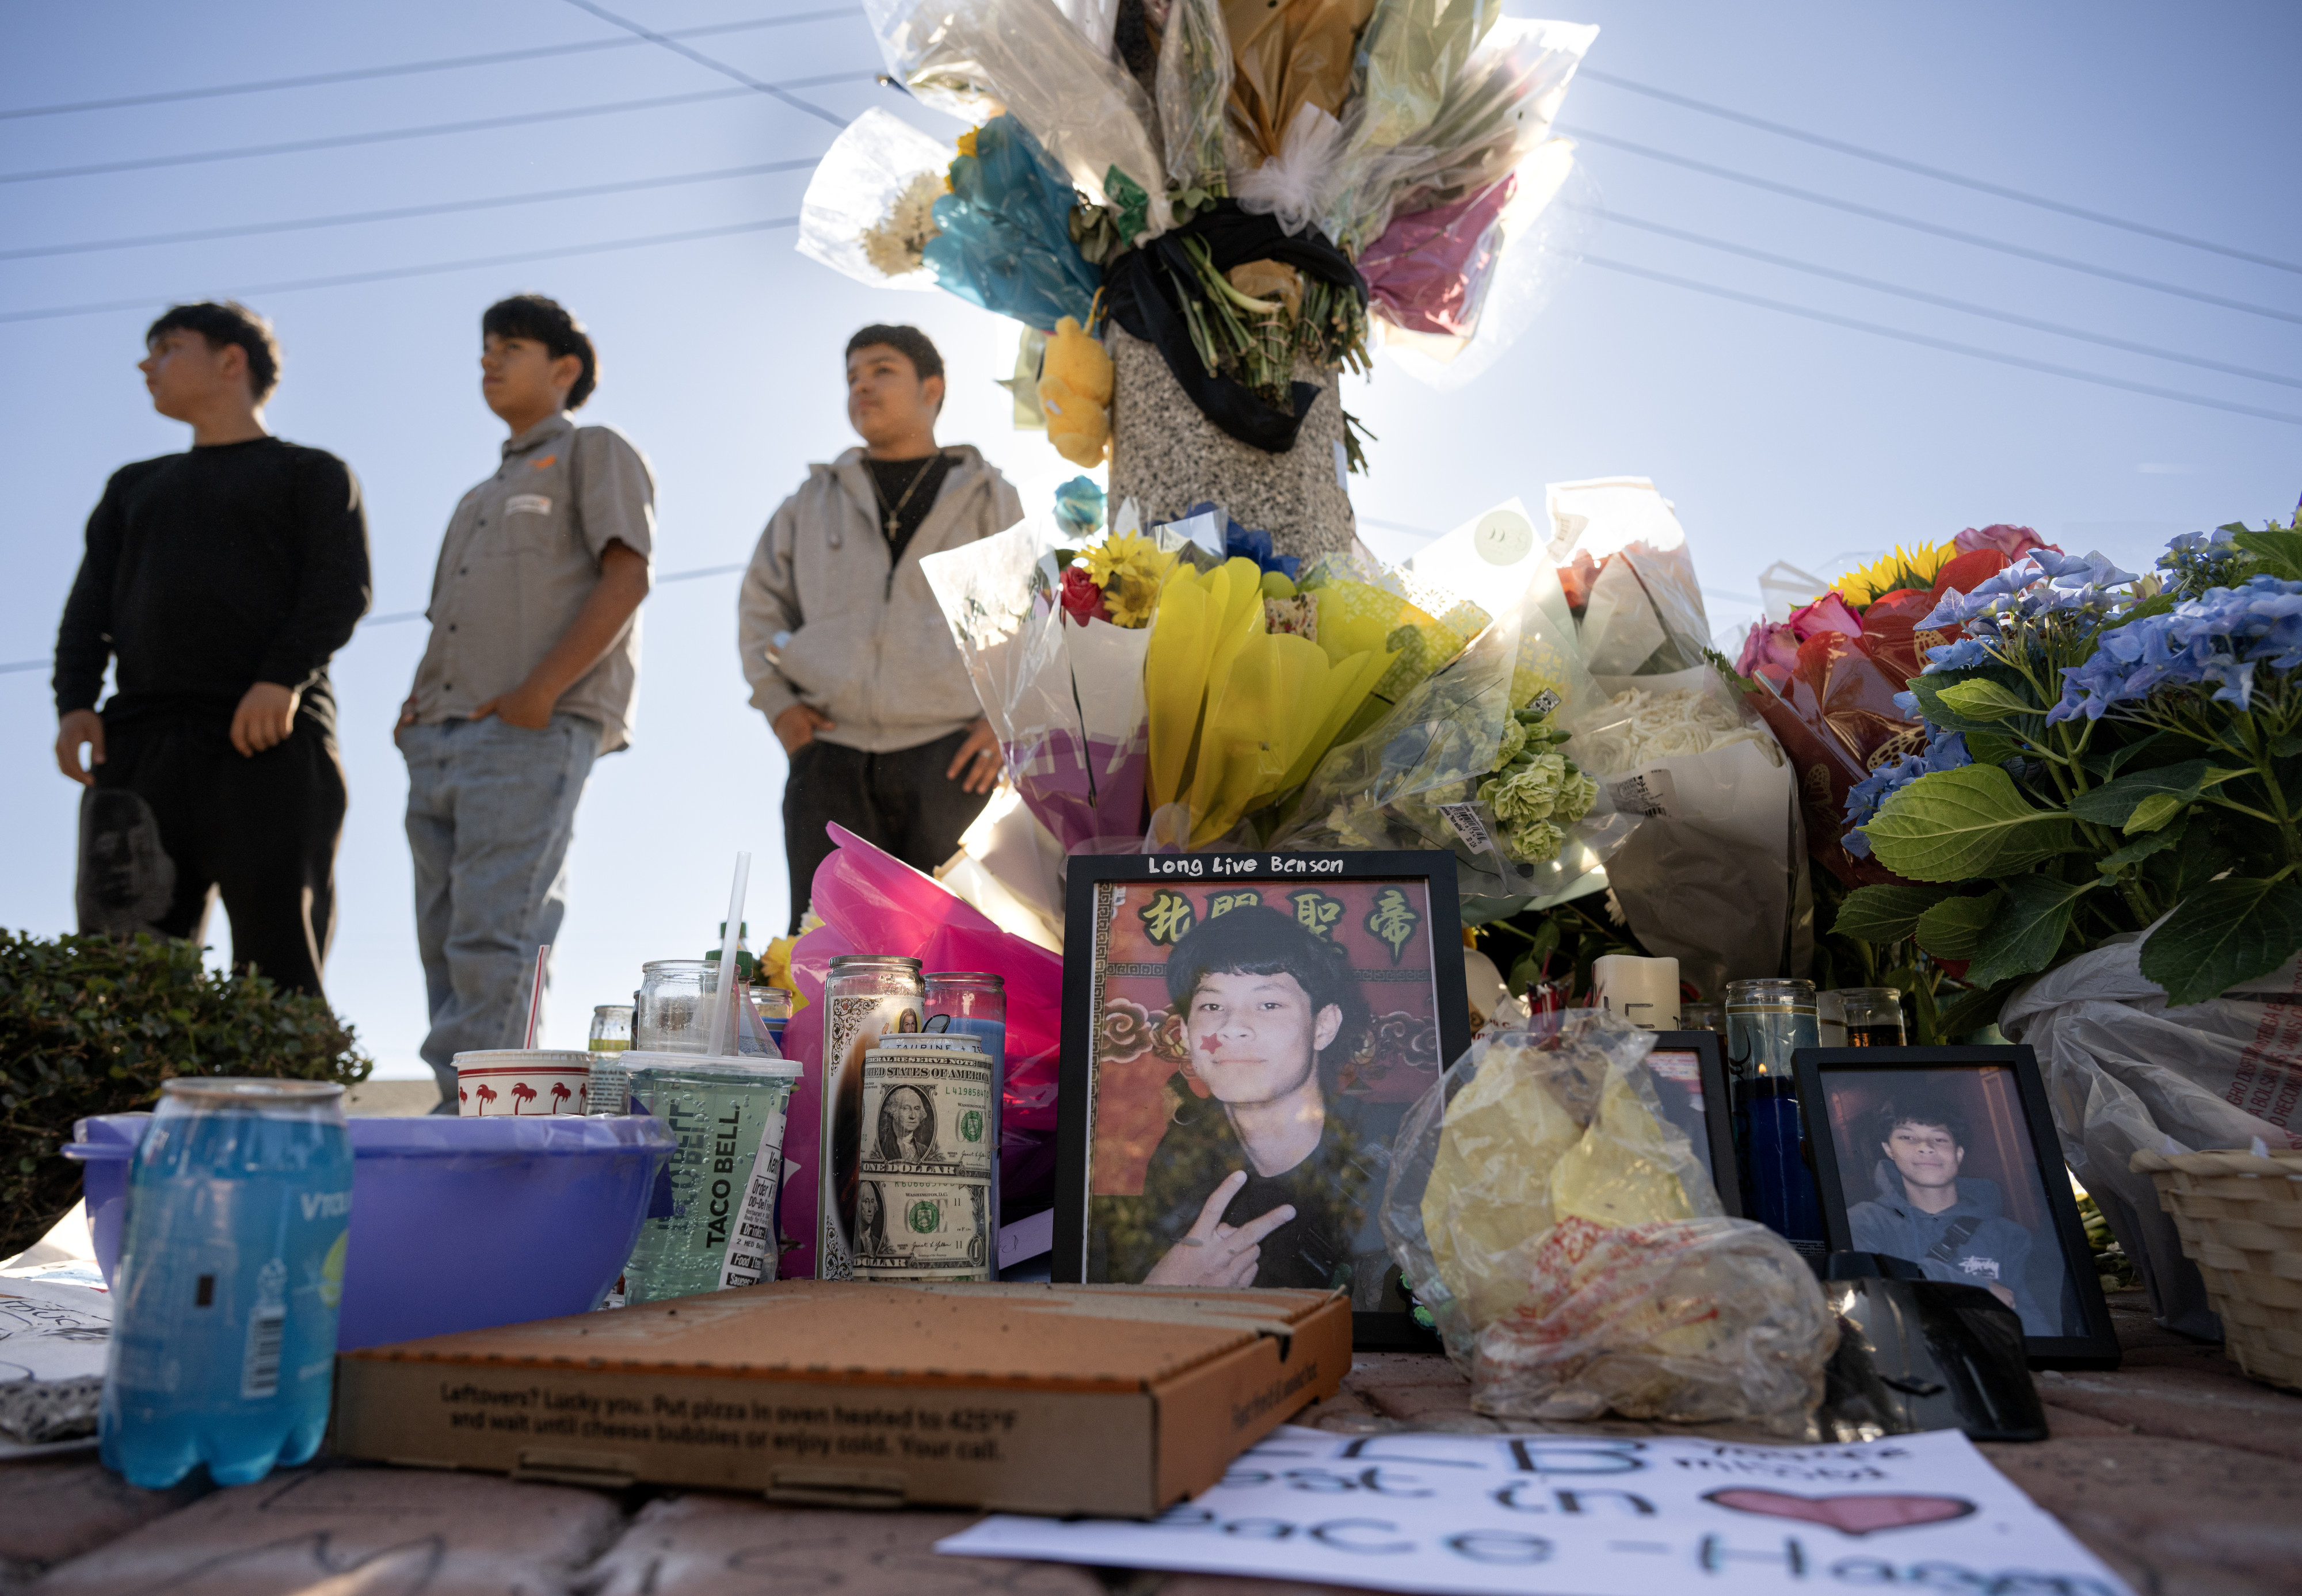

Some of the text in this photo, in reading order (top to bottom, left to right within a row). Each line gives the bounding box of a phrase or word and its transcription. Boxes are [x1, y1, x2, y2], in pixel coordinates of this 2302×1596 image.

[1149, 856, 1344, 876] Long Live Benson
[865, 1067, 990, 1082] NITED STATES OF AMERICA
[863, 1162, 885, 1171] ONE
[887, 1164, 956, 1174] DOLLAR
[706, 1109, 740, 1248] TACO BELL
[752, 1179, 769, 1197] Order
[734, 1253, 751, 1266] Food
[853, 1258, 907, 1266] DOLLAR
[440, 1383, 540, 1407] Leftovers?
[544, 1388, 600, 1416] Lucky
[654, 1393, 687, 1419] Put
[693, 1398, 747, 1425] pizza
[752, 1399, 772, 1422] in
[776, 1403, 830, 1425] oven
[833, 1402, 913, 1429] heated
[918, 1406, 944, 1430] to
[451, 1410, 486, 1431] and
[489, 1413, 529, 1433] wait
[533, 1416, 575, 1437] until
[580, 1419, 651, 1440] cheese
[655, 1422, 740, 1447] bubbles
[748, 1430, 768, 1448] or
[773, 1431, 830, 1458] enjoy
[898, 1435, 951, 1460] Your
